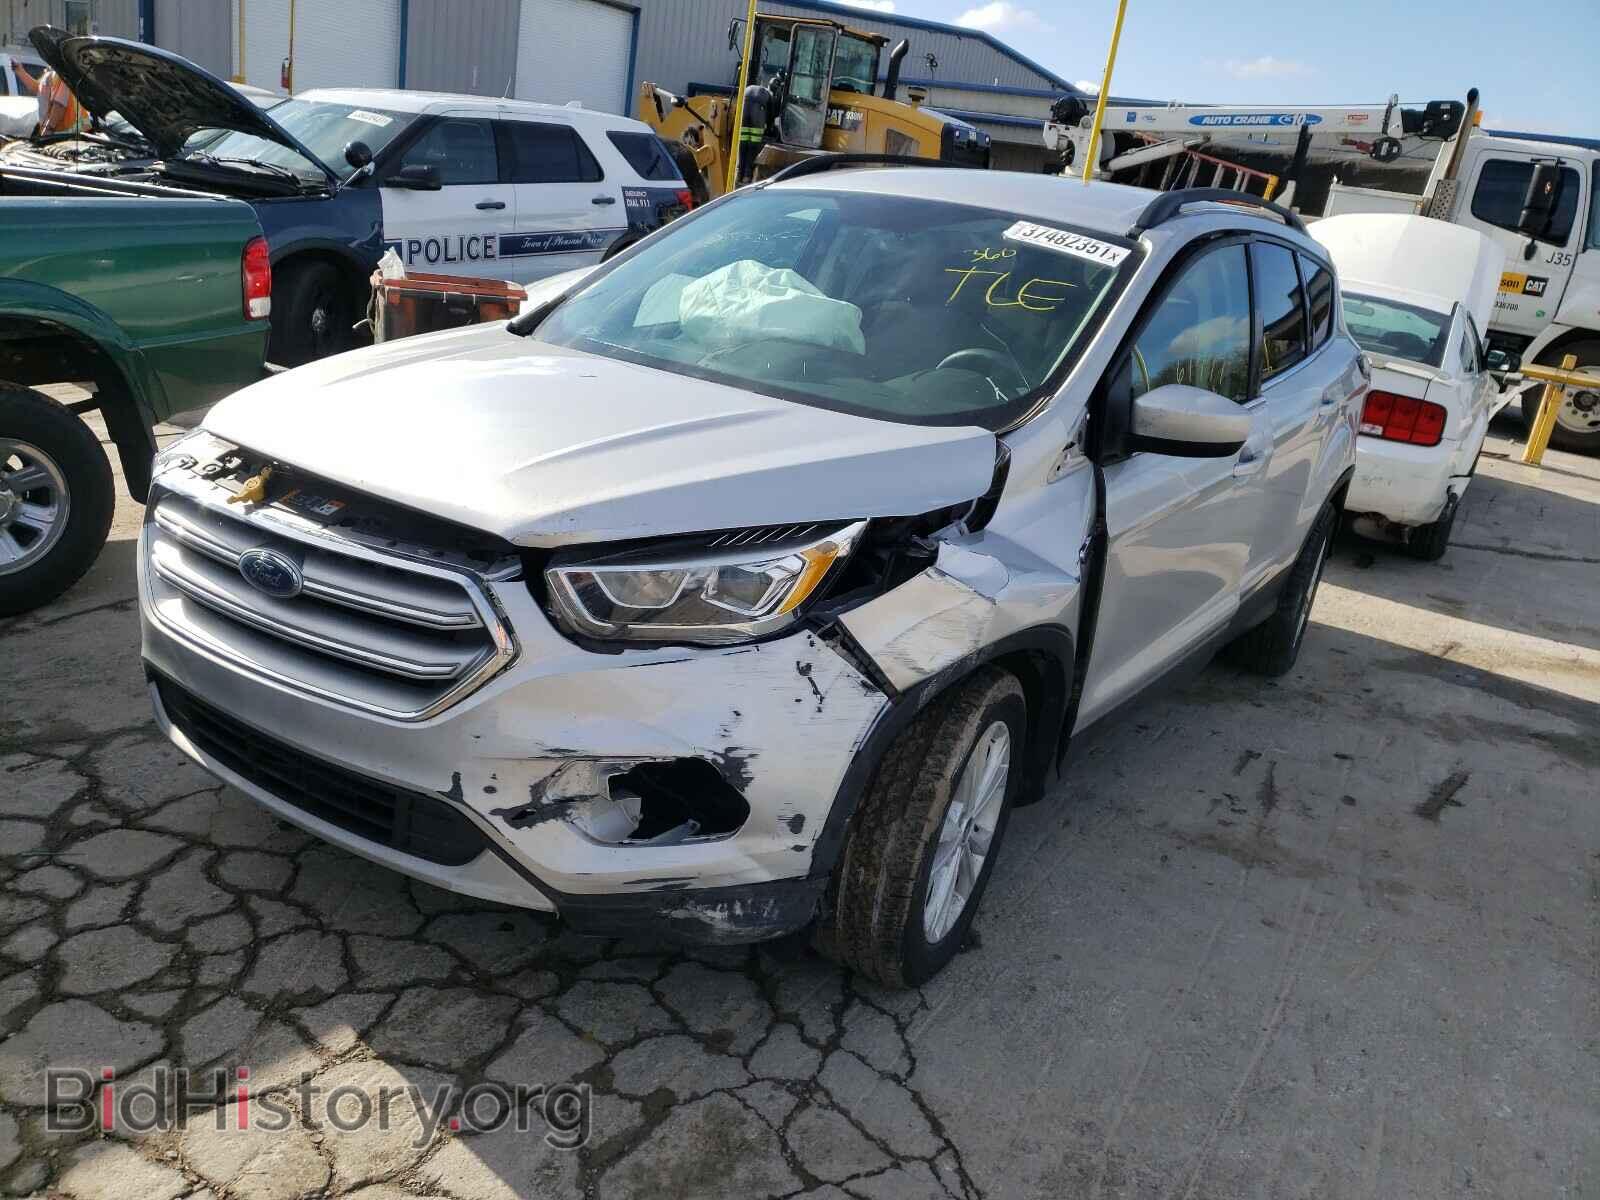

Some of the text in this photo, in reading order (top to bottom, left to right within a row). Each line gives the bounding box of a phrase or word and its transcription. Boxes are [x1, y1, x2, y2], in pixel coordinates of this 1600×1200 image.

[1202, 115, 1231, 125] AUTO
[1233, 115, 1272, 125] CRANE
[406, 235, 497, 265] POLICE
[521, 237, 541, 249] Town
[543, 235, 553, 250] of
[1545, 251, 1572, 266] J35
[1526, 279, 1546, 292] CAT
[248, 558, 284, 587] Ford
